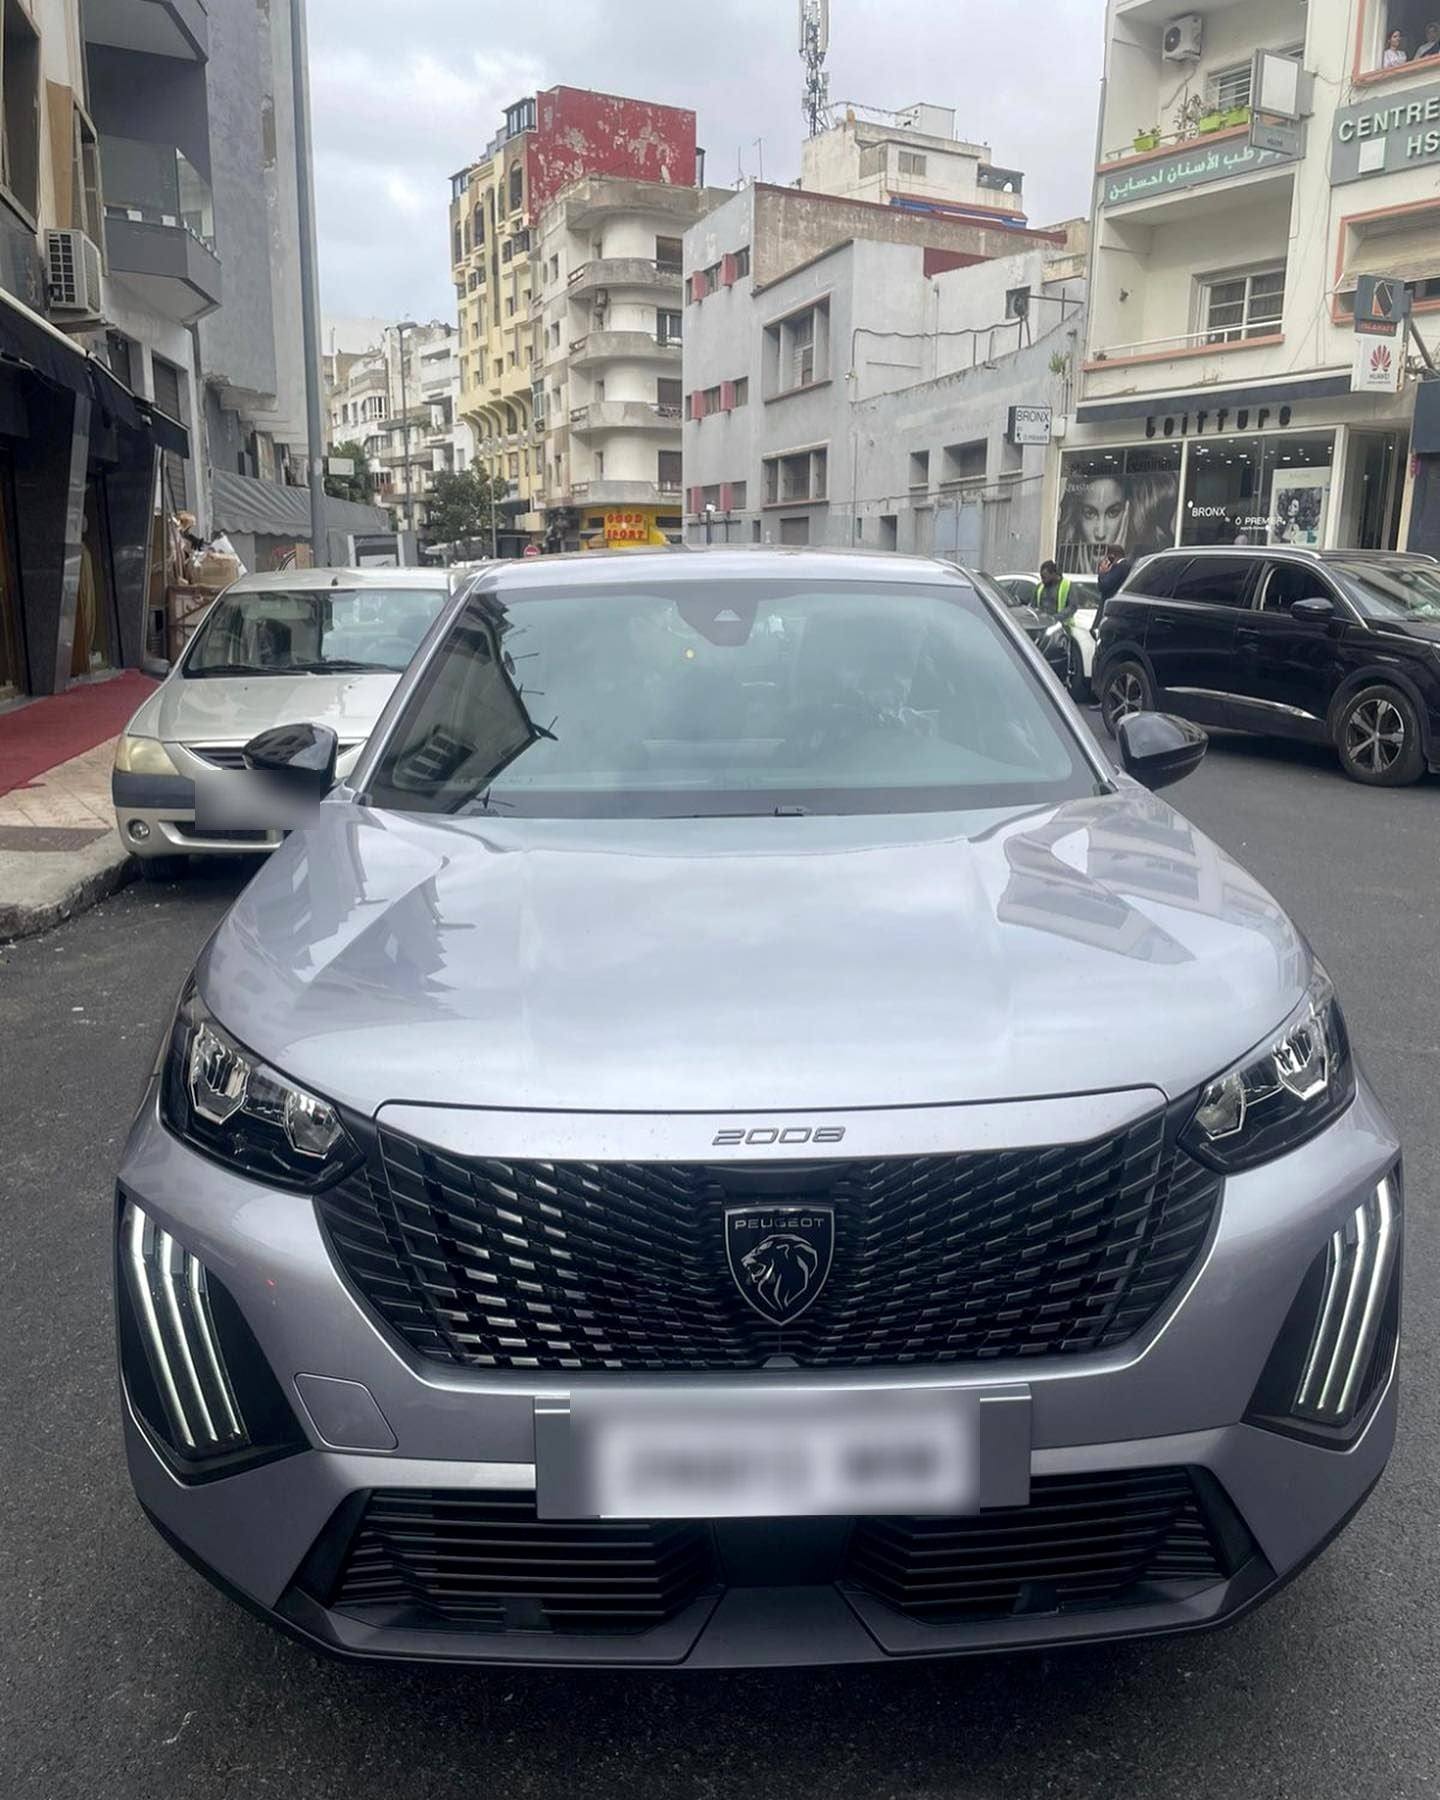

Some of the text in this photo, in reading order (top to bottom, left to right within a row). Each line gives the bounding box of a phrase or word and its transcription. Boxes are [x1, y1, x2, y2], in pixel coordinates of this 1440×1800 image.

[1338, 96, 1440, 142] CENTRE
[1166, 152, 1220, 183] الأسنان
[1016, 410, 1049, 423] BRONX
[1191, 507, 1226, 517] BRONX
[712, 1126, 846, 1146] 2008
[734, 1217, 825, 1231] PEUGEOT
